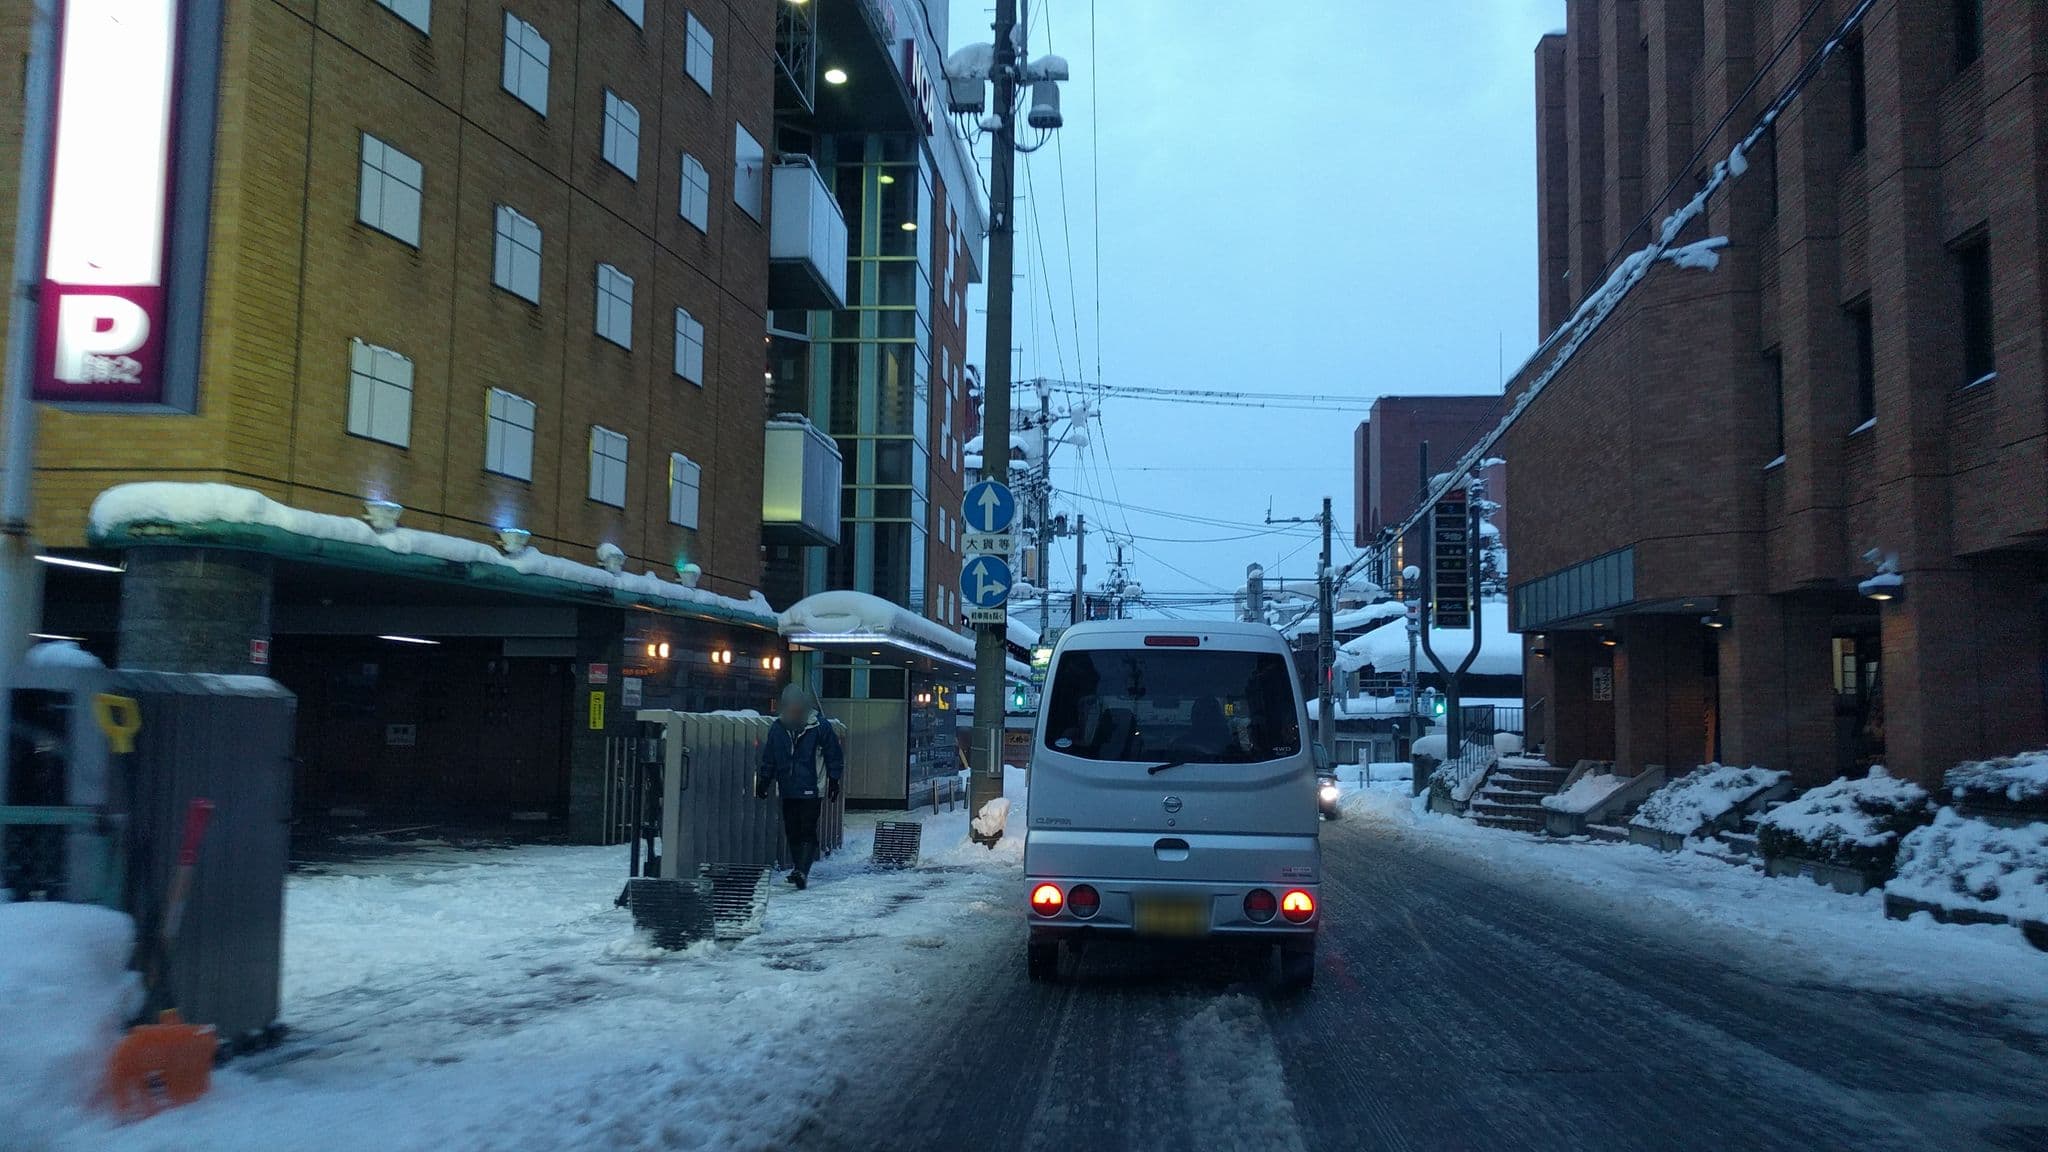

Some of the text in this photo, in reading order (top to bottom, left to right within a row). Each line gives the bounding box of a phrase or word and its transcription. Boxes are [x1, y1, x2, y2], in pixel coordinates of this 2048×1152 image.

[54, 294, 150, 384] P
[966, 538, 1010, 551] 大貨等
